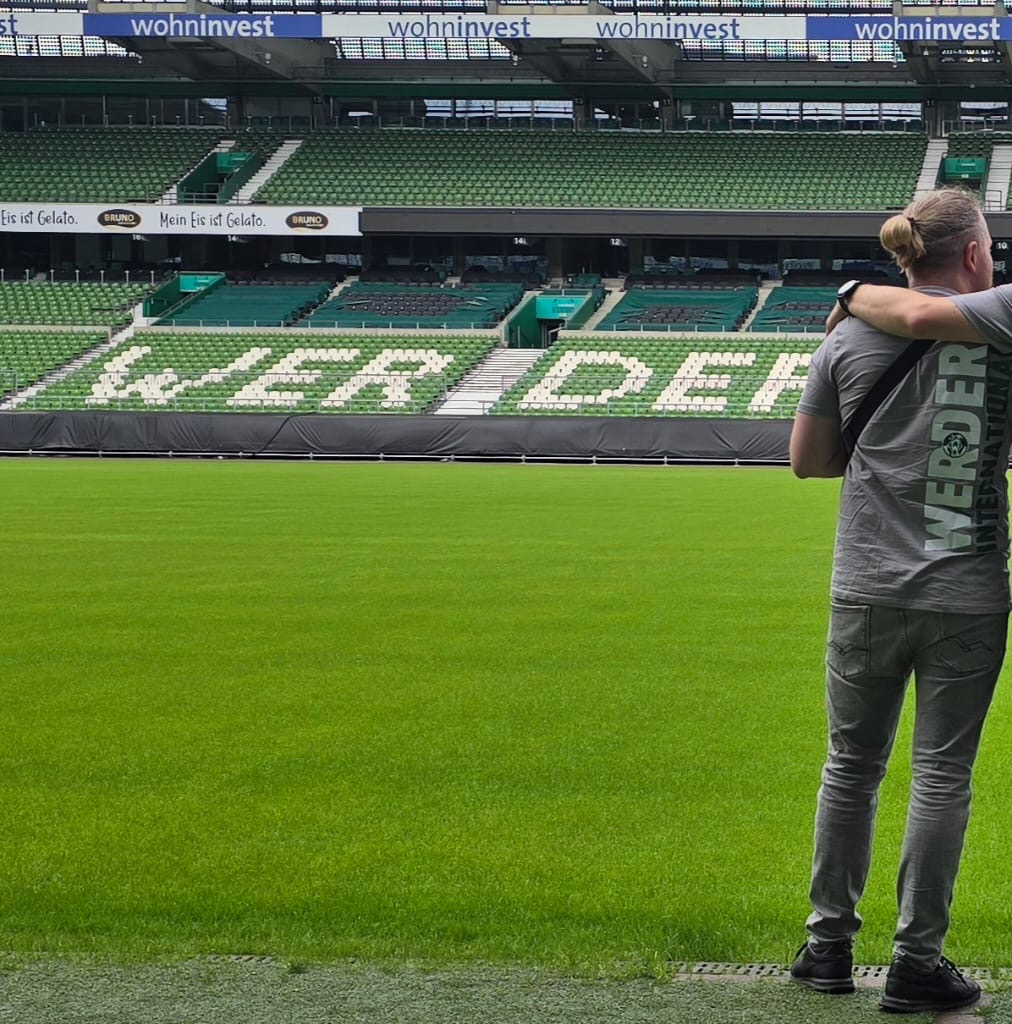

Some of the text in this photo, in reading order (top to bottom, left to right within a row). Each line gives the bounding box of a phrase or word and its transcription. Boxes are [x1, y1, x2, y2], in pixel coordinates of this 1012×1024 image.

[131, 13, 275, 37] wohninvest
[388, 14, 531, 37] wohninvest
[596, 15, 741, 38] wohninvest
[855, 16, 1000, 40] wohninvest
[1, 210, 78, 225] Eis ist Gelato.
[104, 213, 135, 222] BRUNO
[160, 212, 266, 229] Mein Eis ist Gelato.
[292, 215, 322, 224] BRUNO
[923, 343, 989, 553] WERDER
